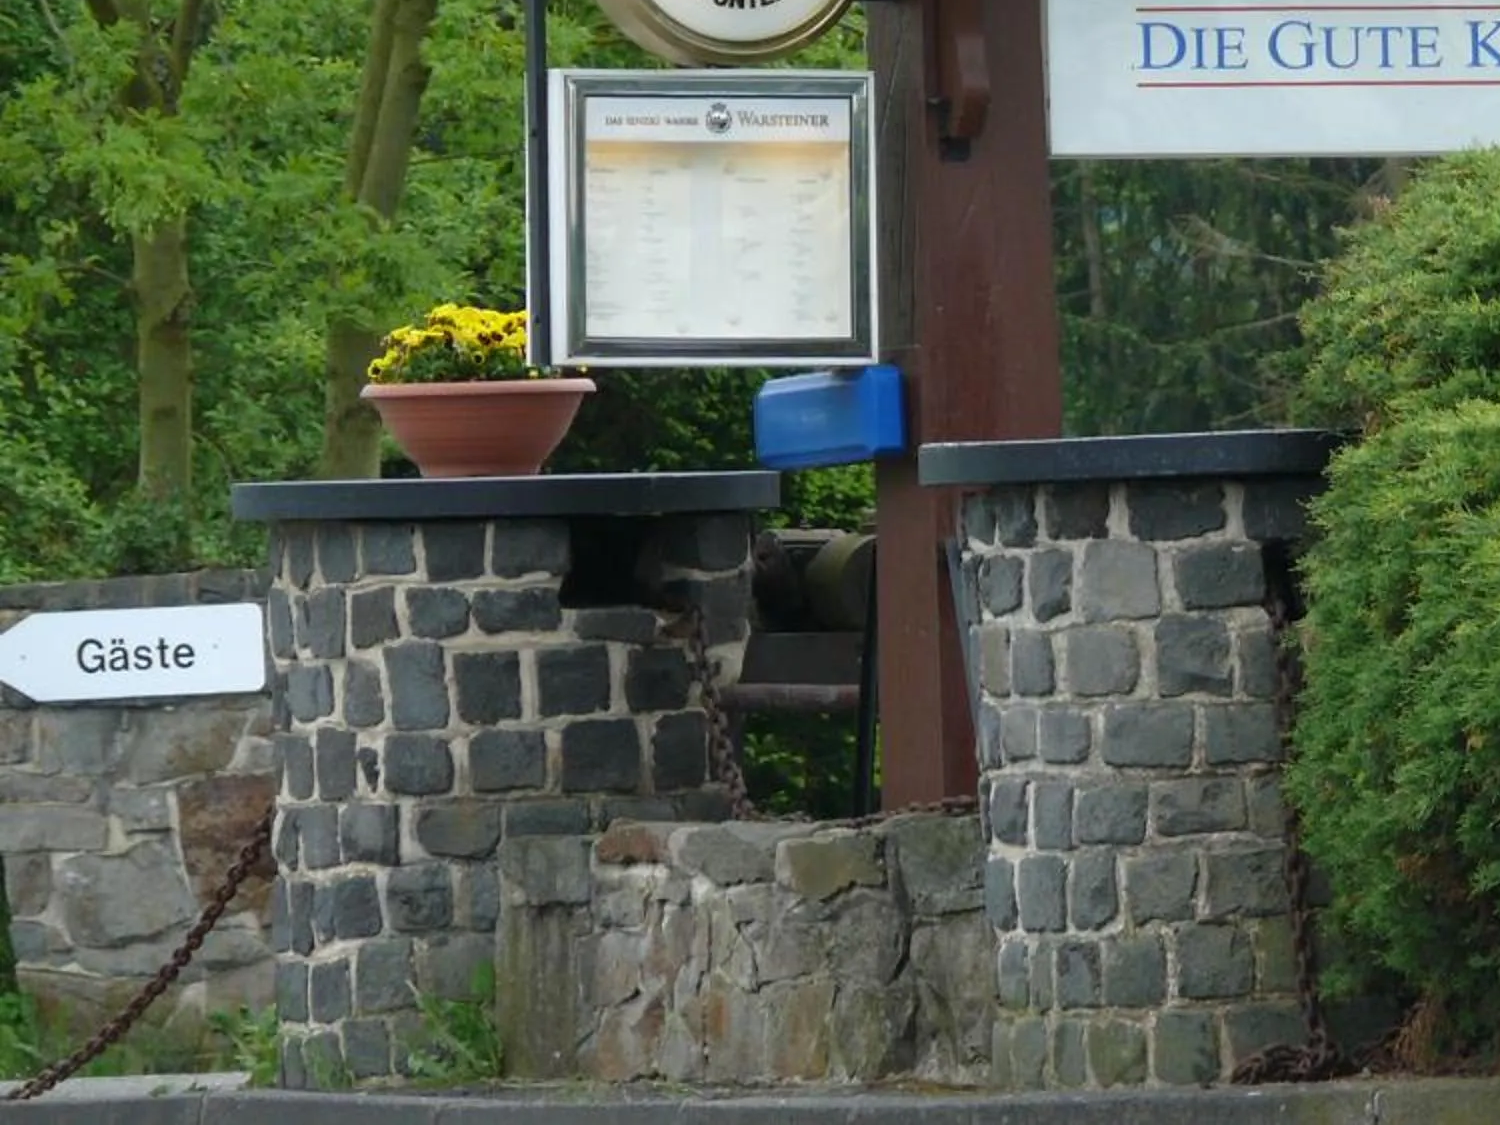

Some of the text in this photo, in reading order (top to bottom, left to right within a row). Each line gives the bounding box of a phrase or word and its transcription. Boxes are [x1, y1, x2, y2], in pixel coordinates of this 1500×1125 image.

[1135, 20, 1249, 71] DIE
[1267, 18, 1443, 71] GUTE
[736, 110, 830, 127] WARSTEINER
[76, 637, 196, 674] Gäste
